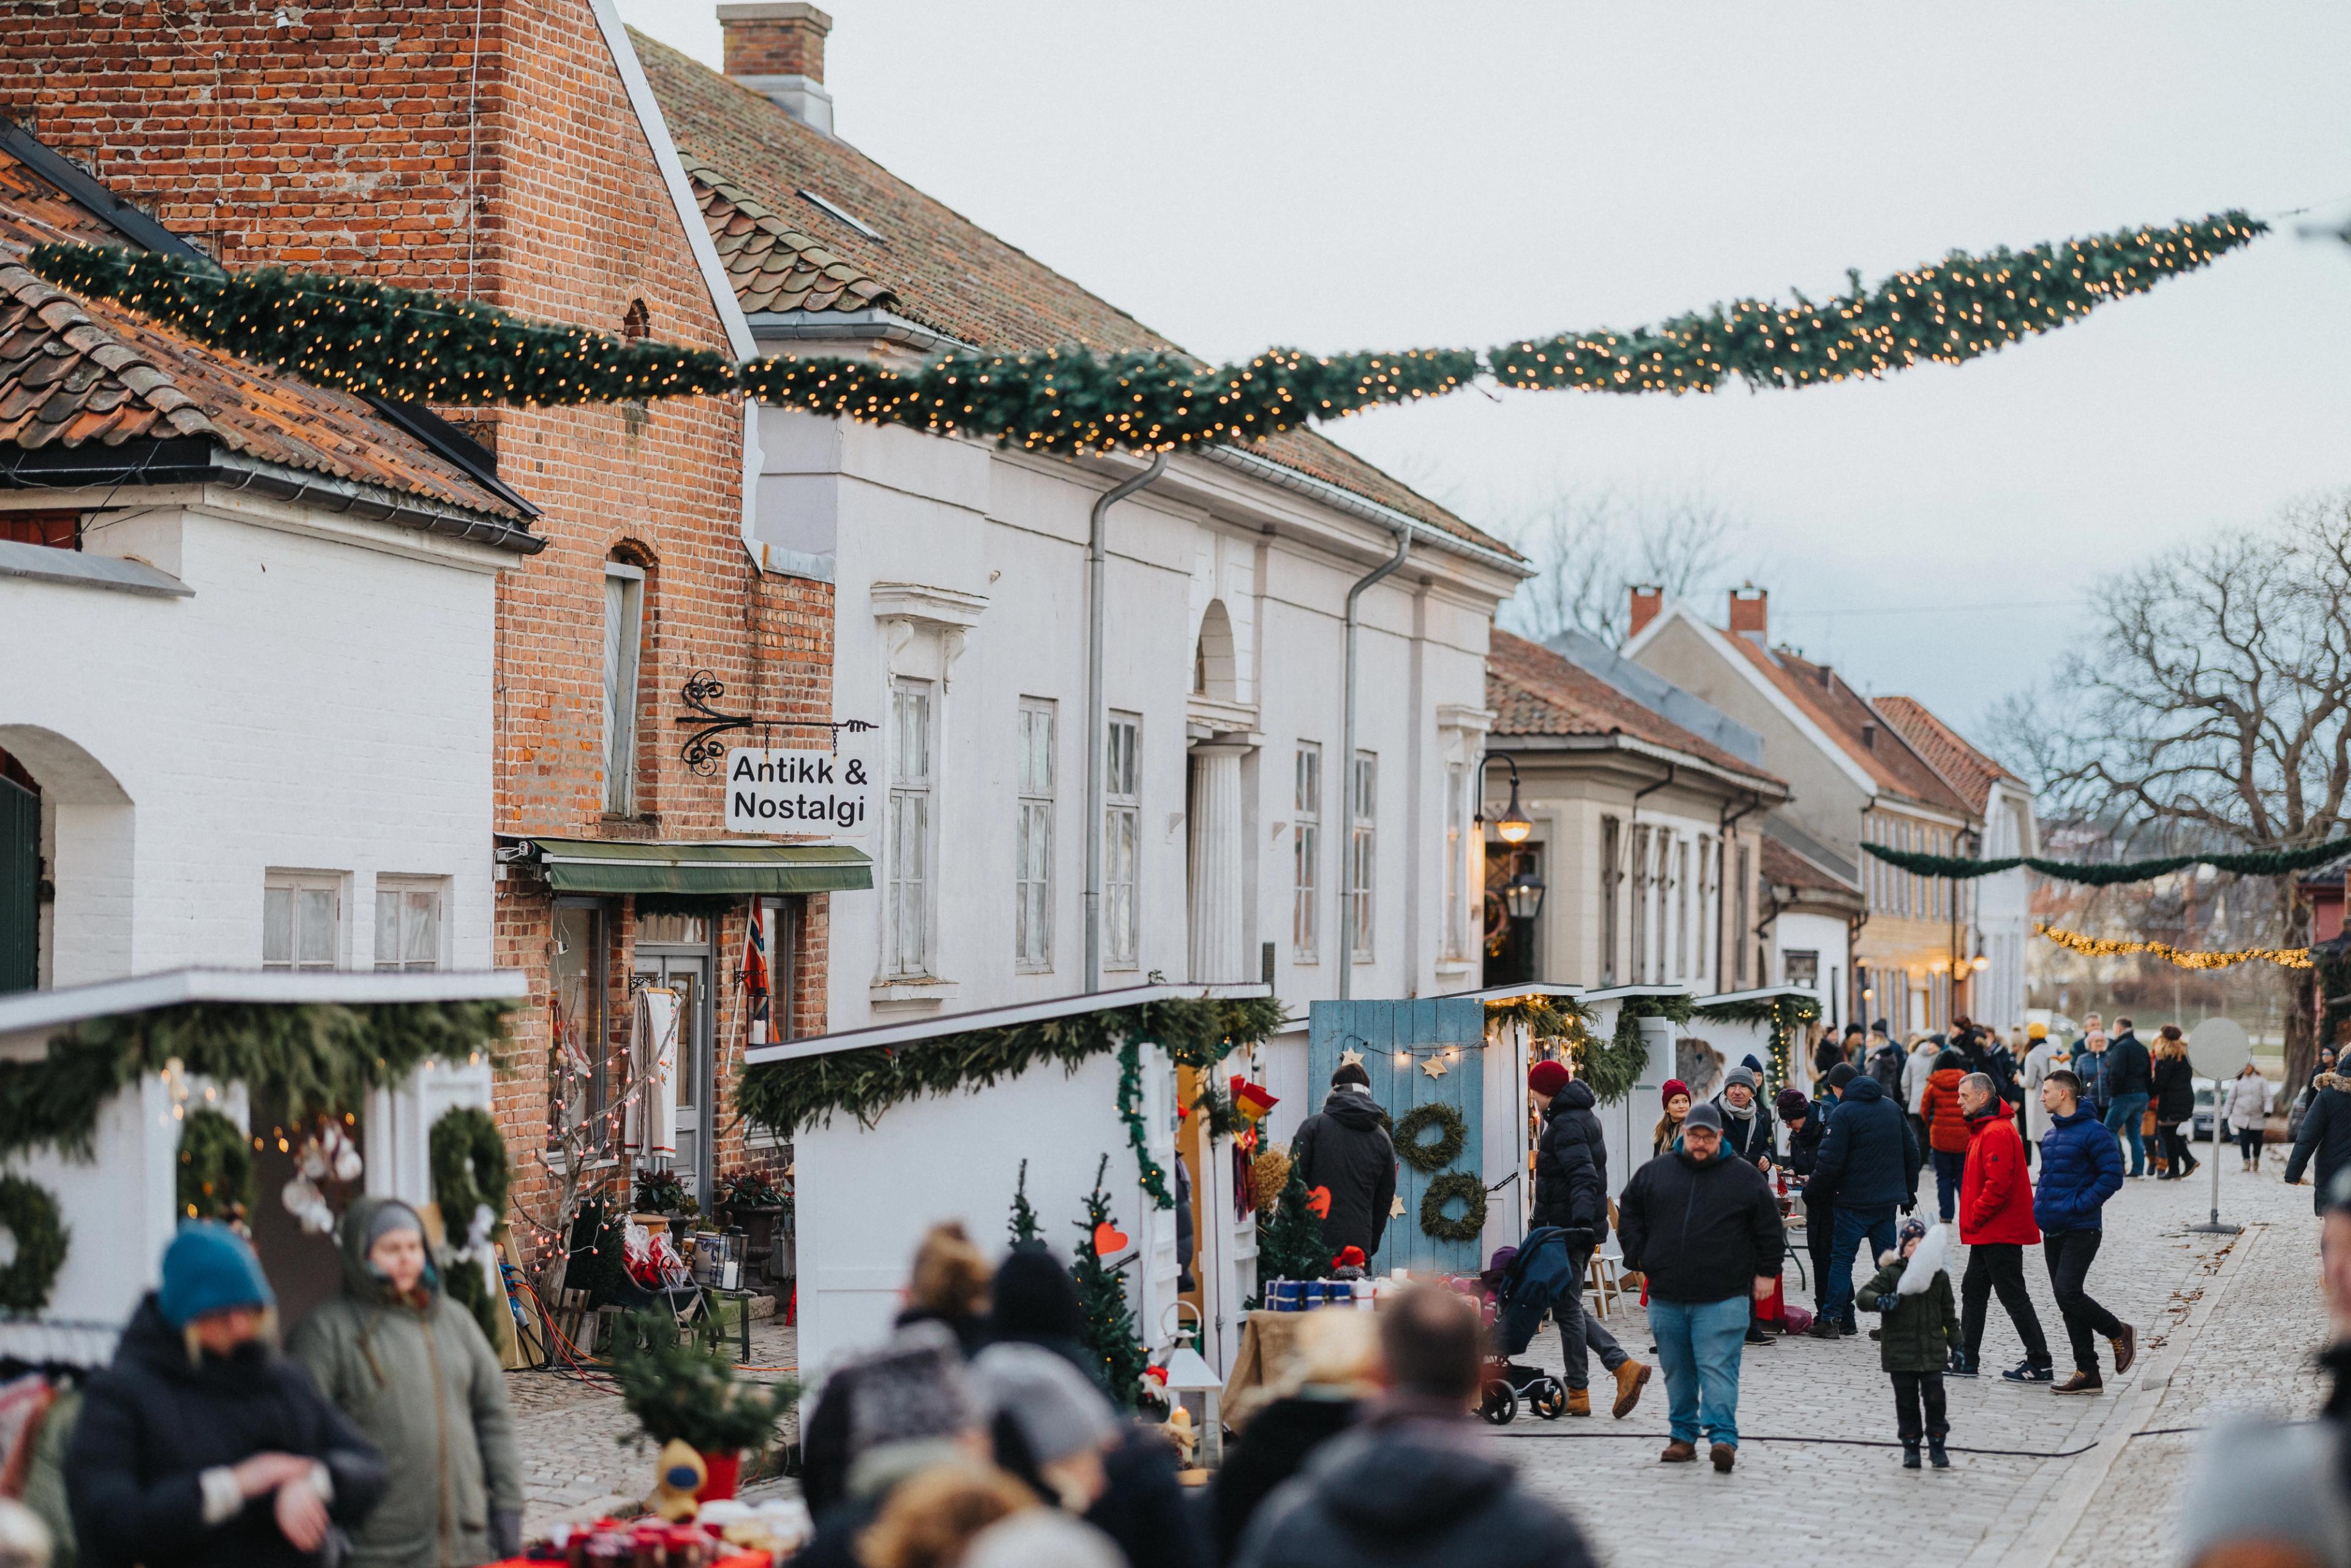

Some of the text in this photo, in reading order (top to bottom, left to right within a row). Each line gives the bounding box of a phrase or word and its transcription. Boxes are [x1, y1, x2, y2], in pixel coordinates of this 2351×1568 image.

[733, 756, 868, 785] Antikk &
[734, 791, 864, 828] Nostalgi
